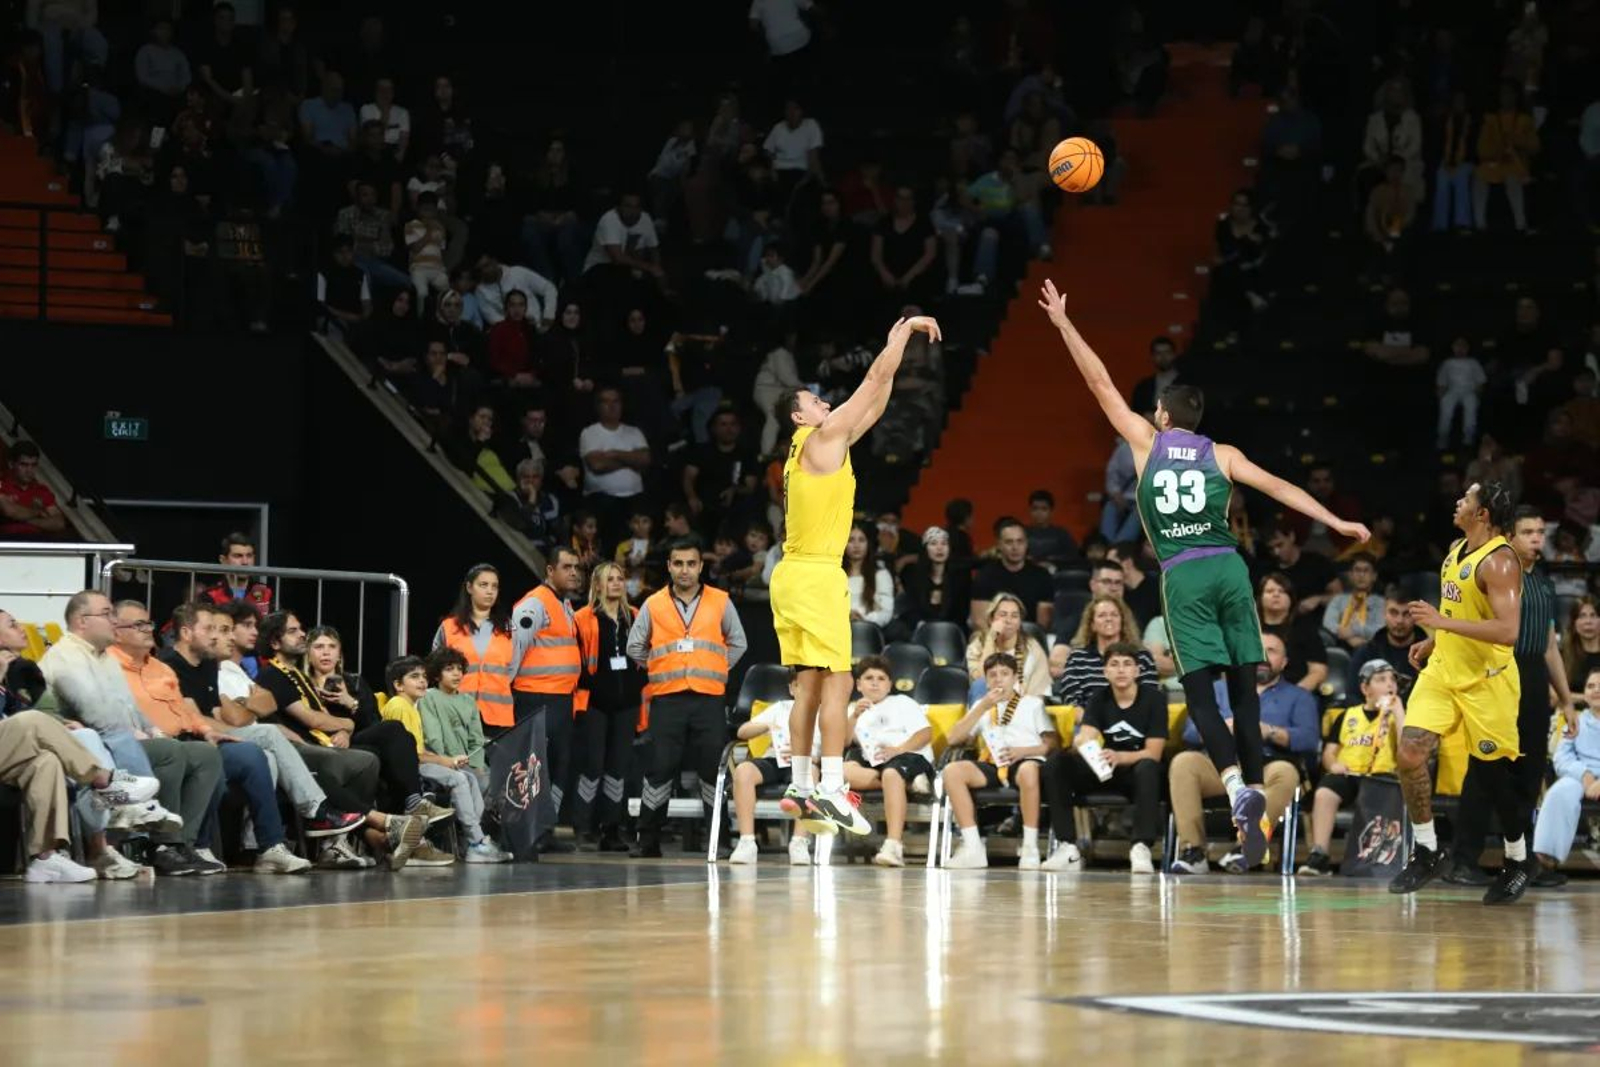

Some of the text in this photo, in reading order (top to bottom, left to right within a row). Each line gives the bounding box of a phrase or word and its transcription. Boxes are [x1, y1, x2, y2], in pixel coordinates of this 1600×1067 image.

[111, 420, 140, 429] EXIT
[1167, 447, 1197, 461] TILLIE
[1153, 469, 1207, 515] 33
